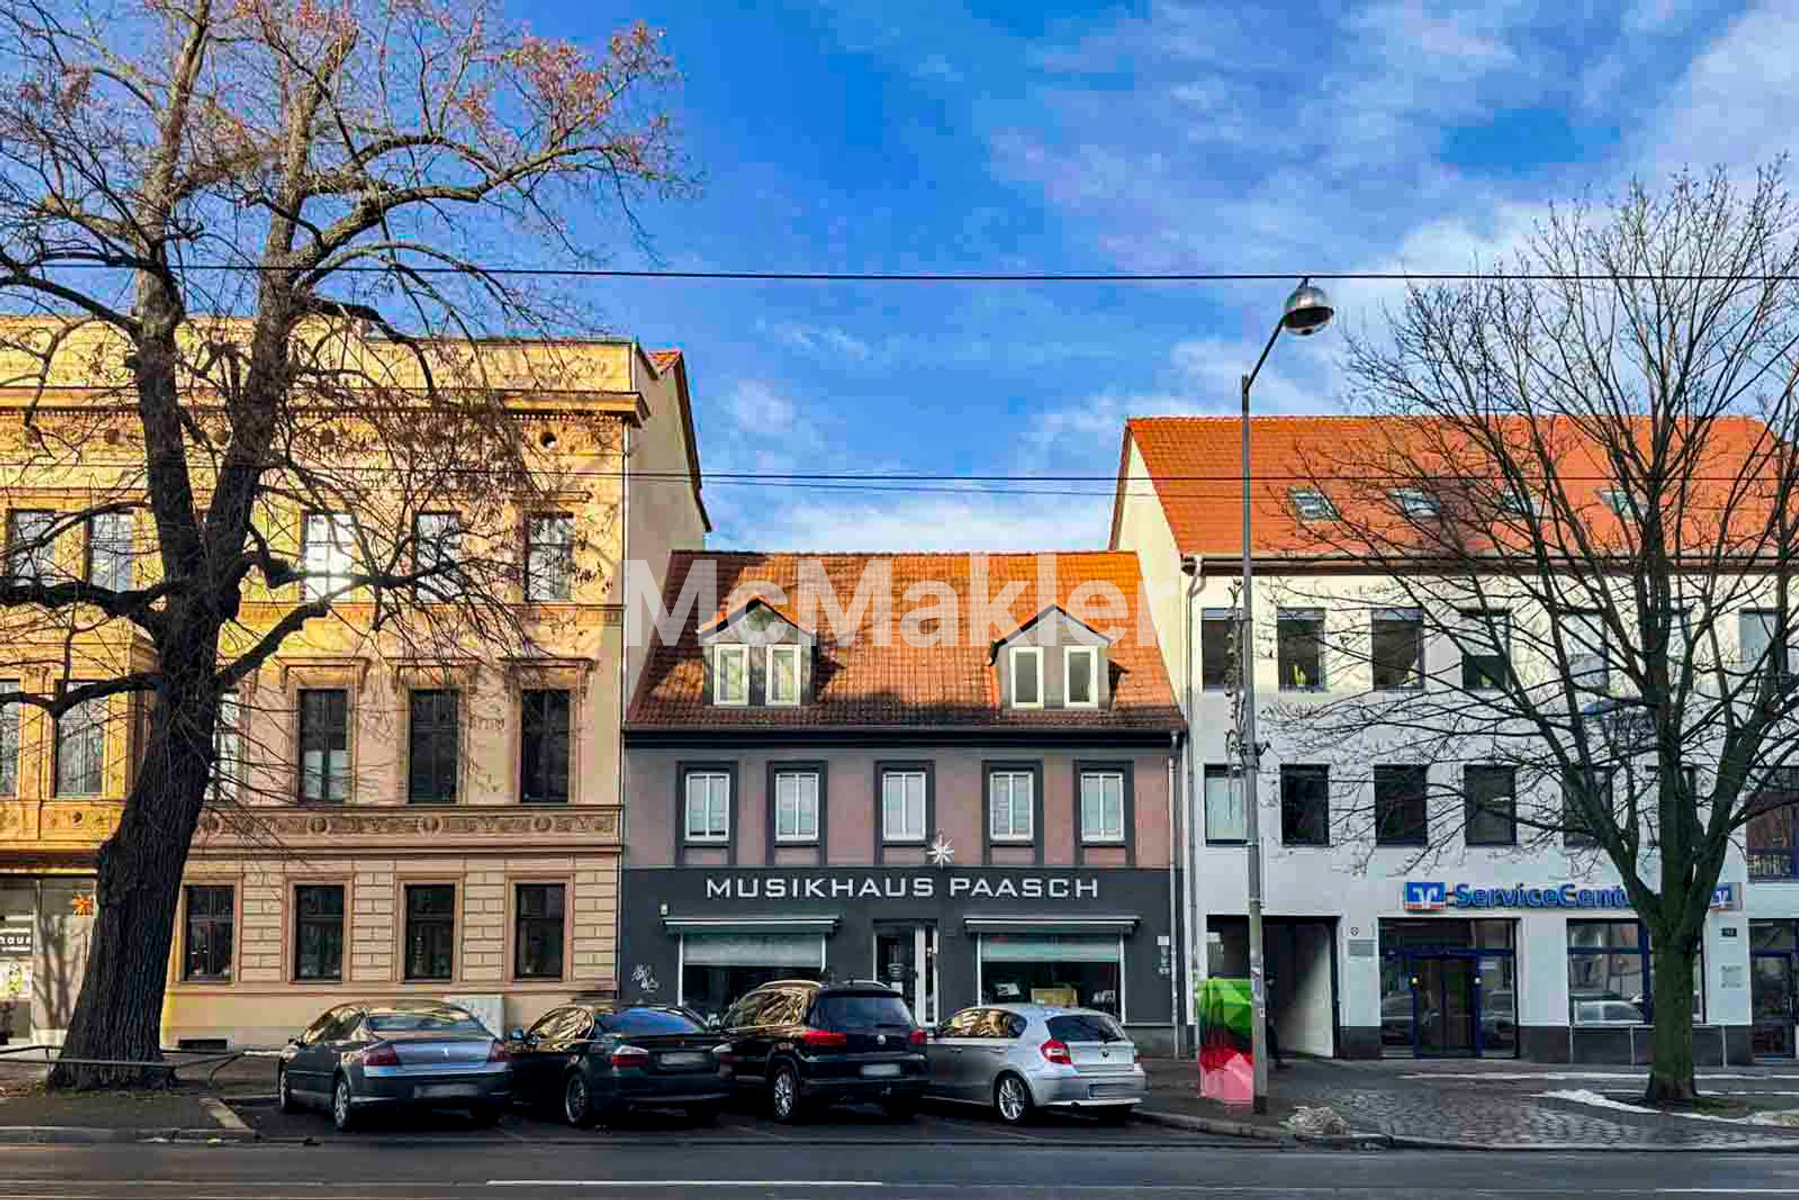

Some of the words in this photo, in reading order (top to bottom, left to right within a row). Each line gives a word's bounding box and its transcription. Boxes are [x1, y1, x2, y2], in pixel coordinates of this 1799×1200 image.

[705, 877, 935, 899] MUSIKHAUS
[949, 877, 1100, 899] PAASCH
[1455, 881, 1629, 908] ServiceCent
